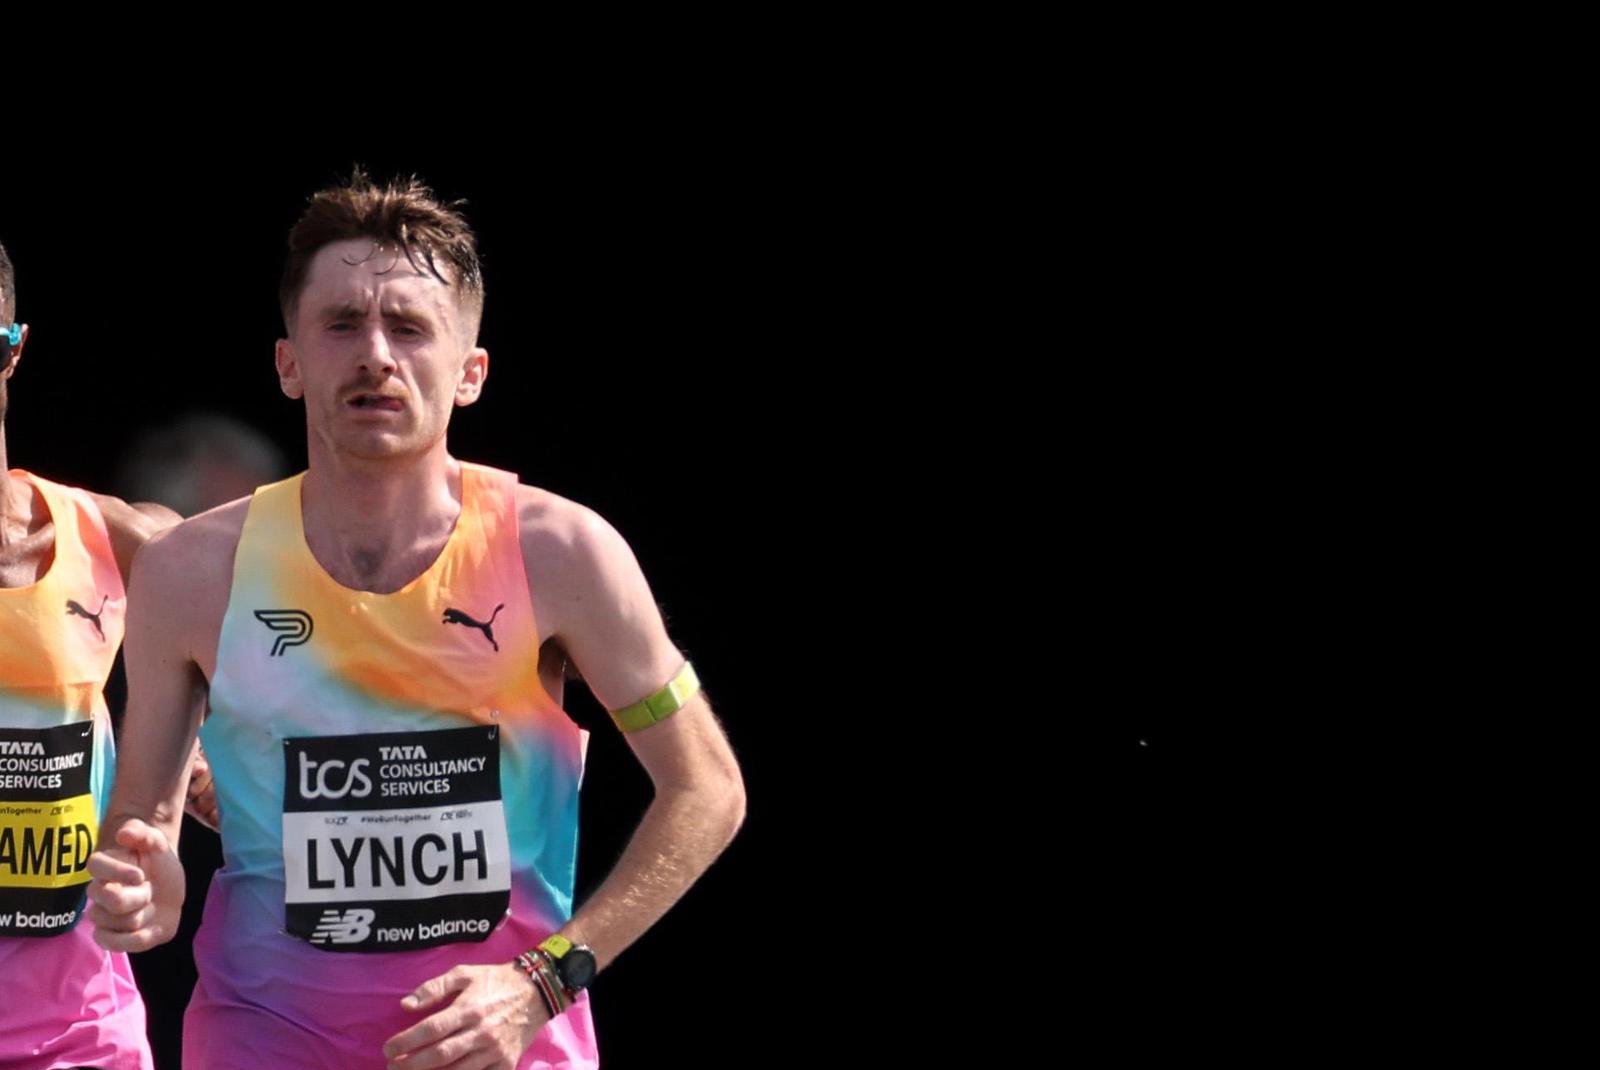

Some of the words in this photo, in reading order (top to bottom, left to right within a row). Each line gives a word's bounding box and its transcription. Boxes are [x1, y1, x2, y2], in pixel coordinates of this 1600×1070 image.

[0, 741, 45, 755] TATA
[379, 745, 428, 761] TATA
[299, 751, 373, 799] tcs
[379, 757, 486, 779] CONSULTANCY
[380, 779, 450, 797] SERVICES
[307, 829, 488, 890] LYNCH
[16, 910, 76, 928] balance
[377, 926, 415, 942] new
[418, 918, 490, 940] balance
